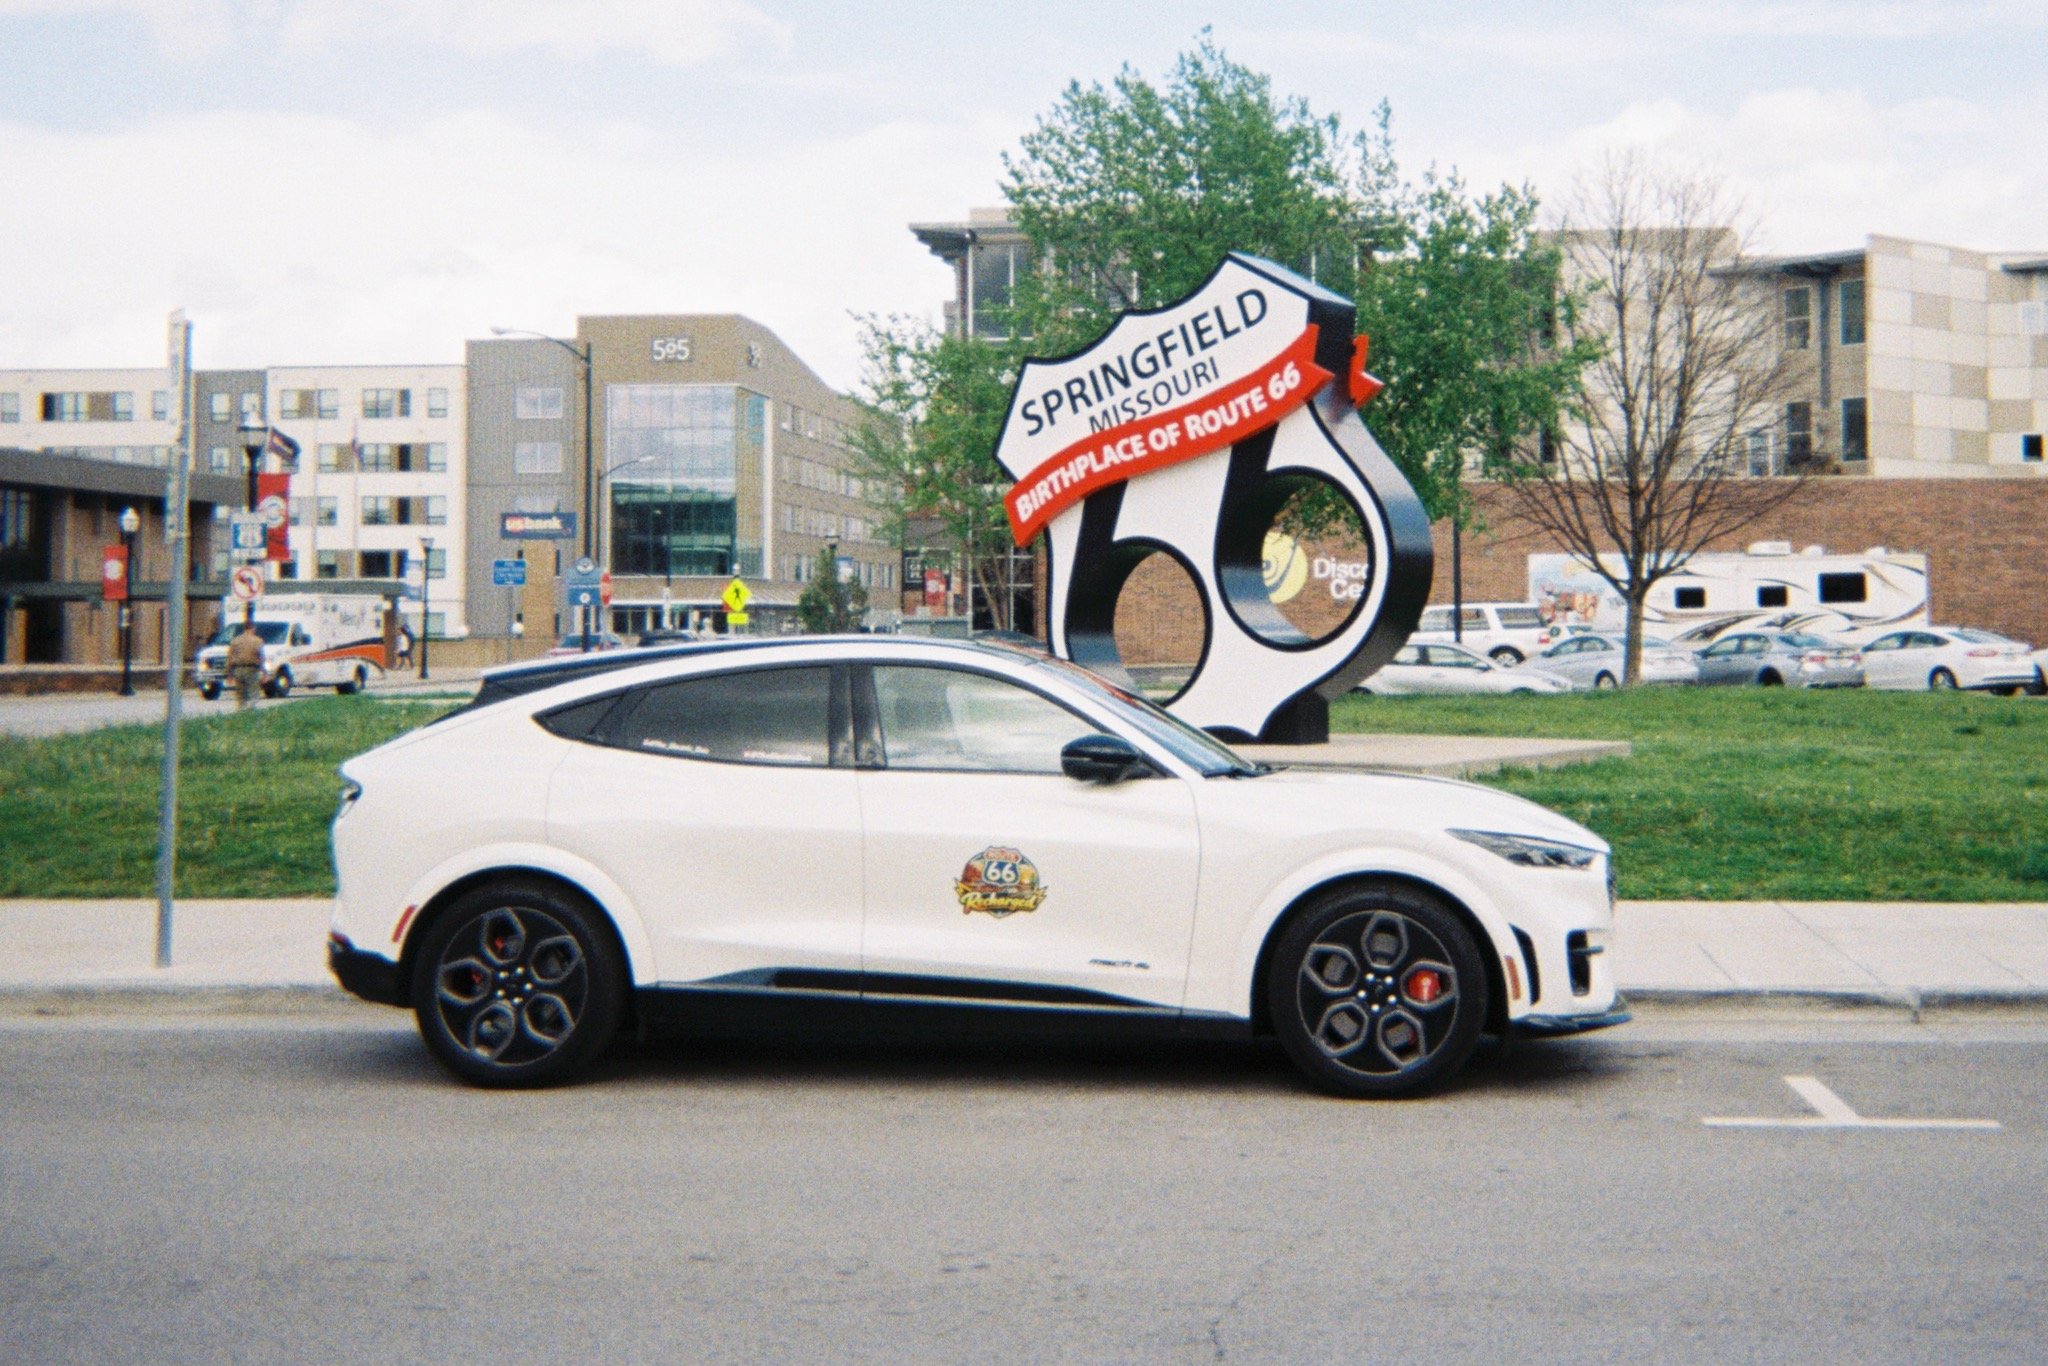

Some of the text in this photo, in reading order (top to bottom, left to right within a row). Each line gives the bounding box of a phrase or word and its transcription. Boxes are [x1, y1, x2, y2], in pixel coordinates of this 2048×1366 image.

[1021, 288, 1269, 437] SPRINGFIELD
[1088, 356, 1220, 435] MISSOURI
[1015, 361, 1301, 523] BIRTHPLACE OF ROUTE 66
[986, 860, 1017, 882] 66
